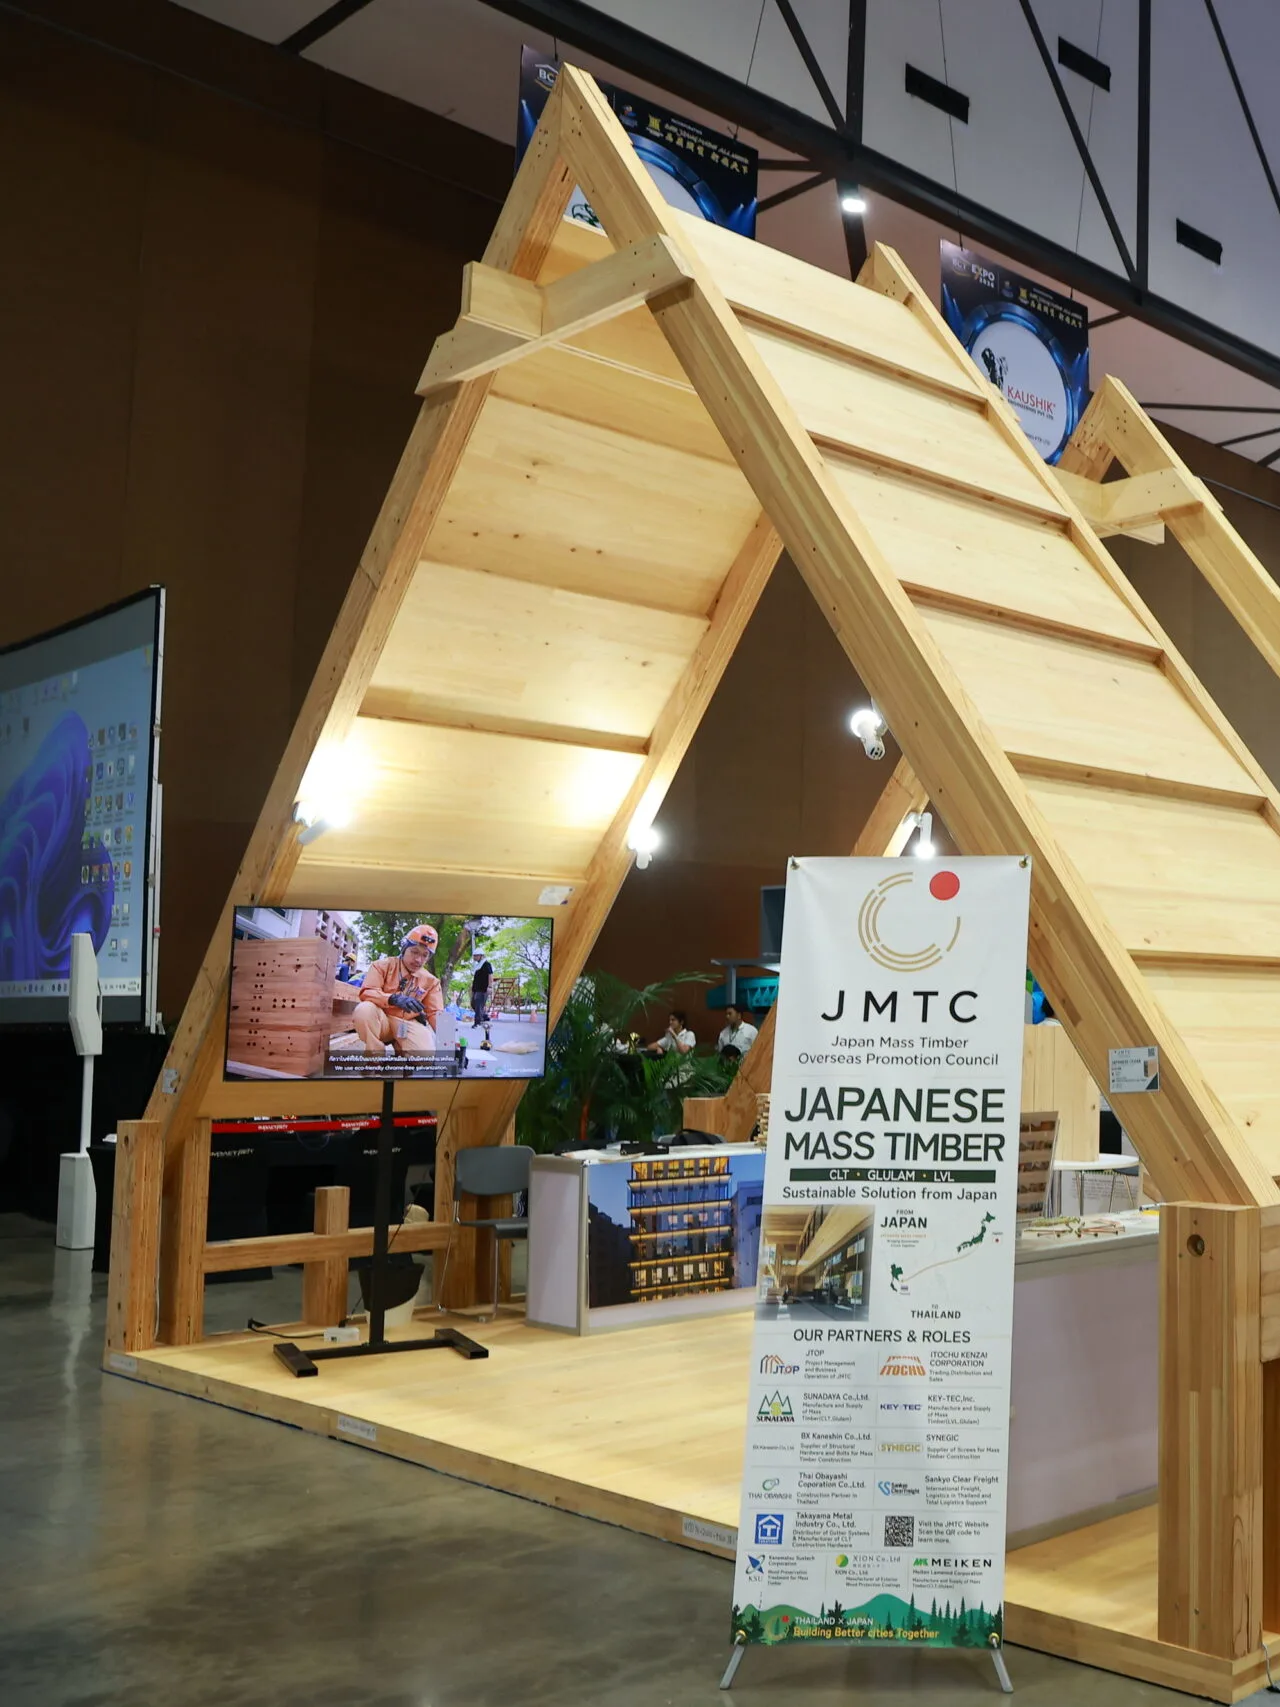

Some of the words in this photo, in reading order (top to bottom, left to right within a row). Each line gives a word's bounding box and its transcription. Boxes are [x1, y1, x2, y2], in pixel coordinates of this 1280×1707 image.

[972, 264, 995, 280] EXPO
[1008, 385, 1053, 415] KAUSHIK
[821, 990, 978, 1023] JMTC
[832, 1036, 874, 1048] Japan
[880, 1037, 914, 1048] Mass
[919, 1037, 968, 1049] Timber
[798, 1053, 862, 1065] Overseas
[866, 1054, 941, 1066] Promotion
[946, 1054, 998, 1066] Council
[785, 1087, 1005, 1123] JAPANESE
[784, 1132, 875, 1161] MASS
[884, 1133, 1005, 1162] TIMBER
[829, 1169, 849, 1180] CLT
[868, 1170, 915, 1181] GLULAM
[934, 1171, 954, 1182] LVL
[783, 1186, 856, 1199] Sustainable
[861, 1187, 916, 1199] Solution
[922, 1188, 952, 1200] from
[957, 1188, 997, 1202] Japan
[880, 1217, 927, 1229] JAPAN
[911, 1310, 961, 1319] THAILAND
[794, 1329, 823, 1341] OUR
[828, 1330, 902, 1342] PARTNERS
[907, 1331, 916, 1342] &
[922, 1331, 971, 1343] ROLES
[773, 1365, 800, 1374] JTOP
[880, 1365, 926, 1376] ITOCHU
[815, 1472, 848, 1481] Obayashi
[925, 1475, 950, 1484] Sankyo
[974, 1476, 998, 1484] Freight
[798, 1480, 836, 1489] Coporation
[797, 1512, 830, 1521] Takayama
[932, 1559, 992, 1568] MEIKEN
[794, 1617, 835, 1625] THAILAND
[846, 1617, 873, 1625] JAPAN
[793, 1627, 832, 1638] Building
[835, 1627, 865, 1638] Better
[868, 1627, 893, 1638] cities
[896, 1628, 939, 1640] Together
